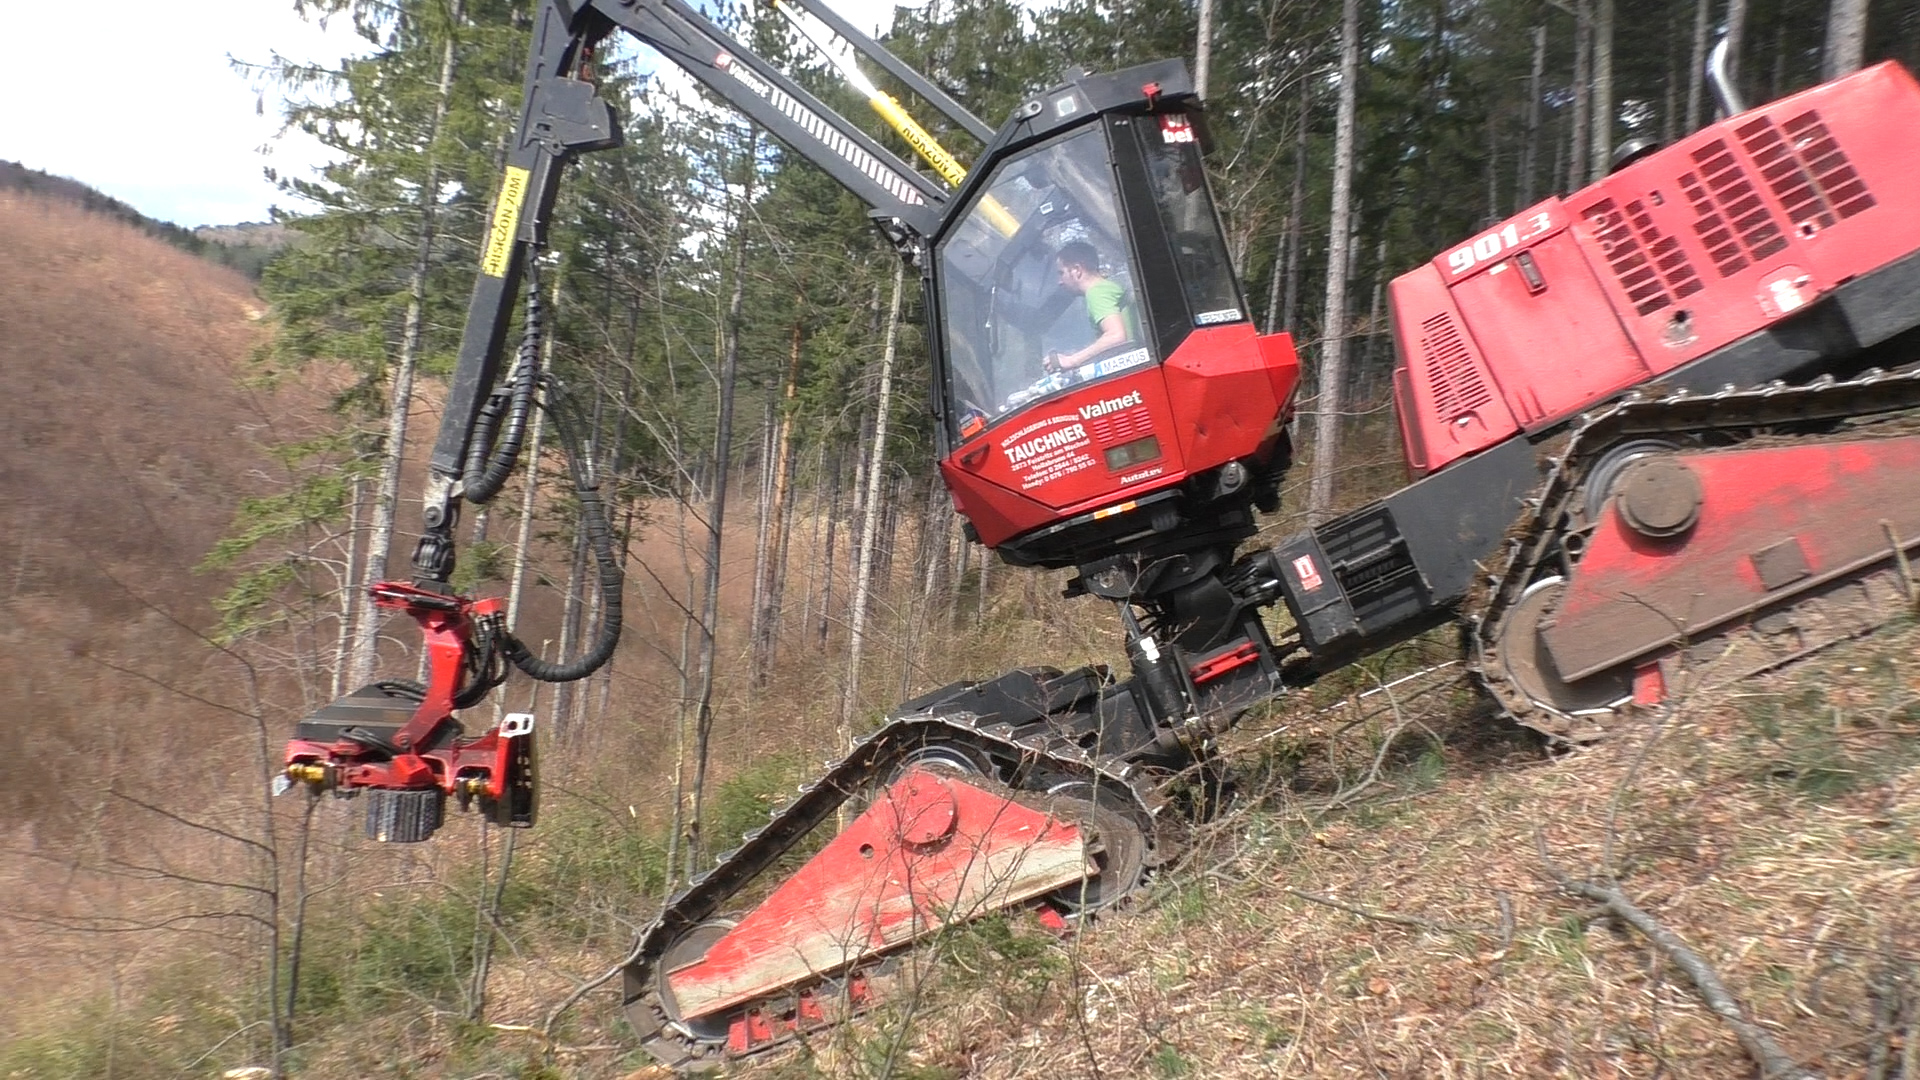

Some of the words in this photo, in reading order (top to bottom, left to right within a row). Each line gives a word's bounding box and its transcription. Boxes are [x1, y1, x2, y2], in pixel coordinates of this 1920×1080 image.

[729, 61, 770, 98] Valmet
[1448, 212, 1551, 275] 901.3
[1104, 351, 1147, 372] MARKUS
[1079, 390, 1143, 421] Valmet
[1004, 423, 1087, 463] TAUCHNER
[1064, 438, 1090, 451] Wechsel
